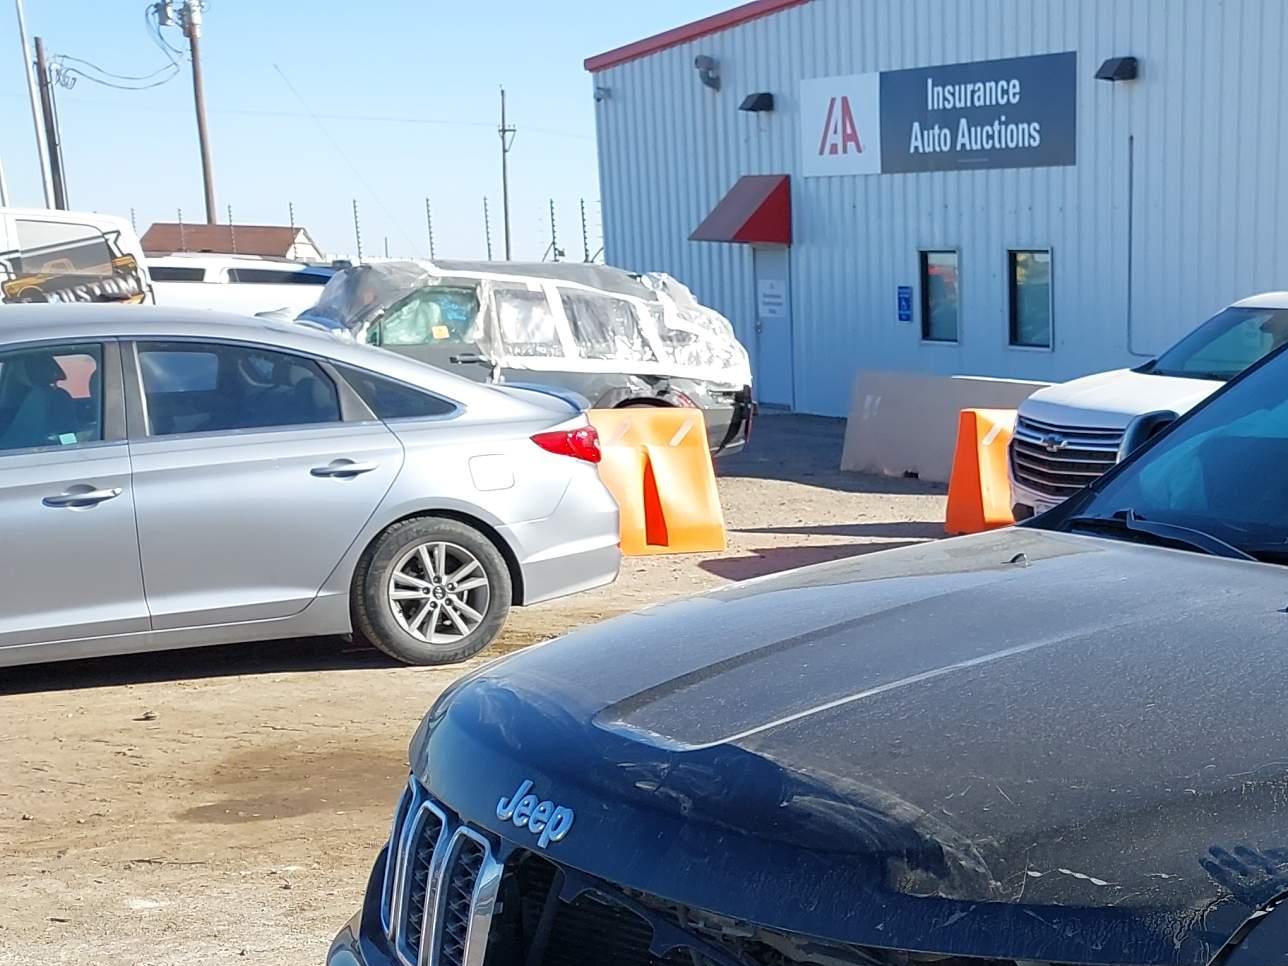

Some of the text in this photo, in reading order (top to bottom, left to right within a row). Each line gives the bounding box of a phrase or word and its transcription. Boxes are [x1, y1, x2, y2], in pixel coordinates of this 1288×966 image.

[926, 77, 1021, 111] Insurance
[909, 114, 1041, 154] Auto Auctions
[496, 779, 575, 849] Jeep
